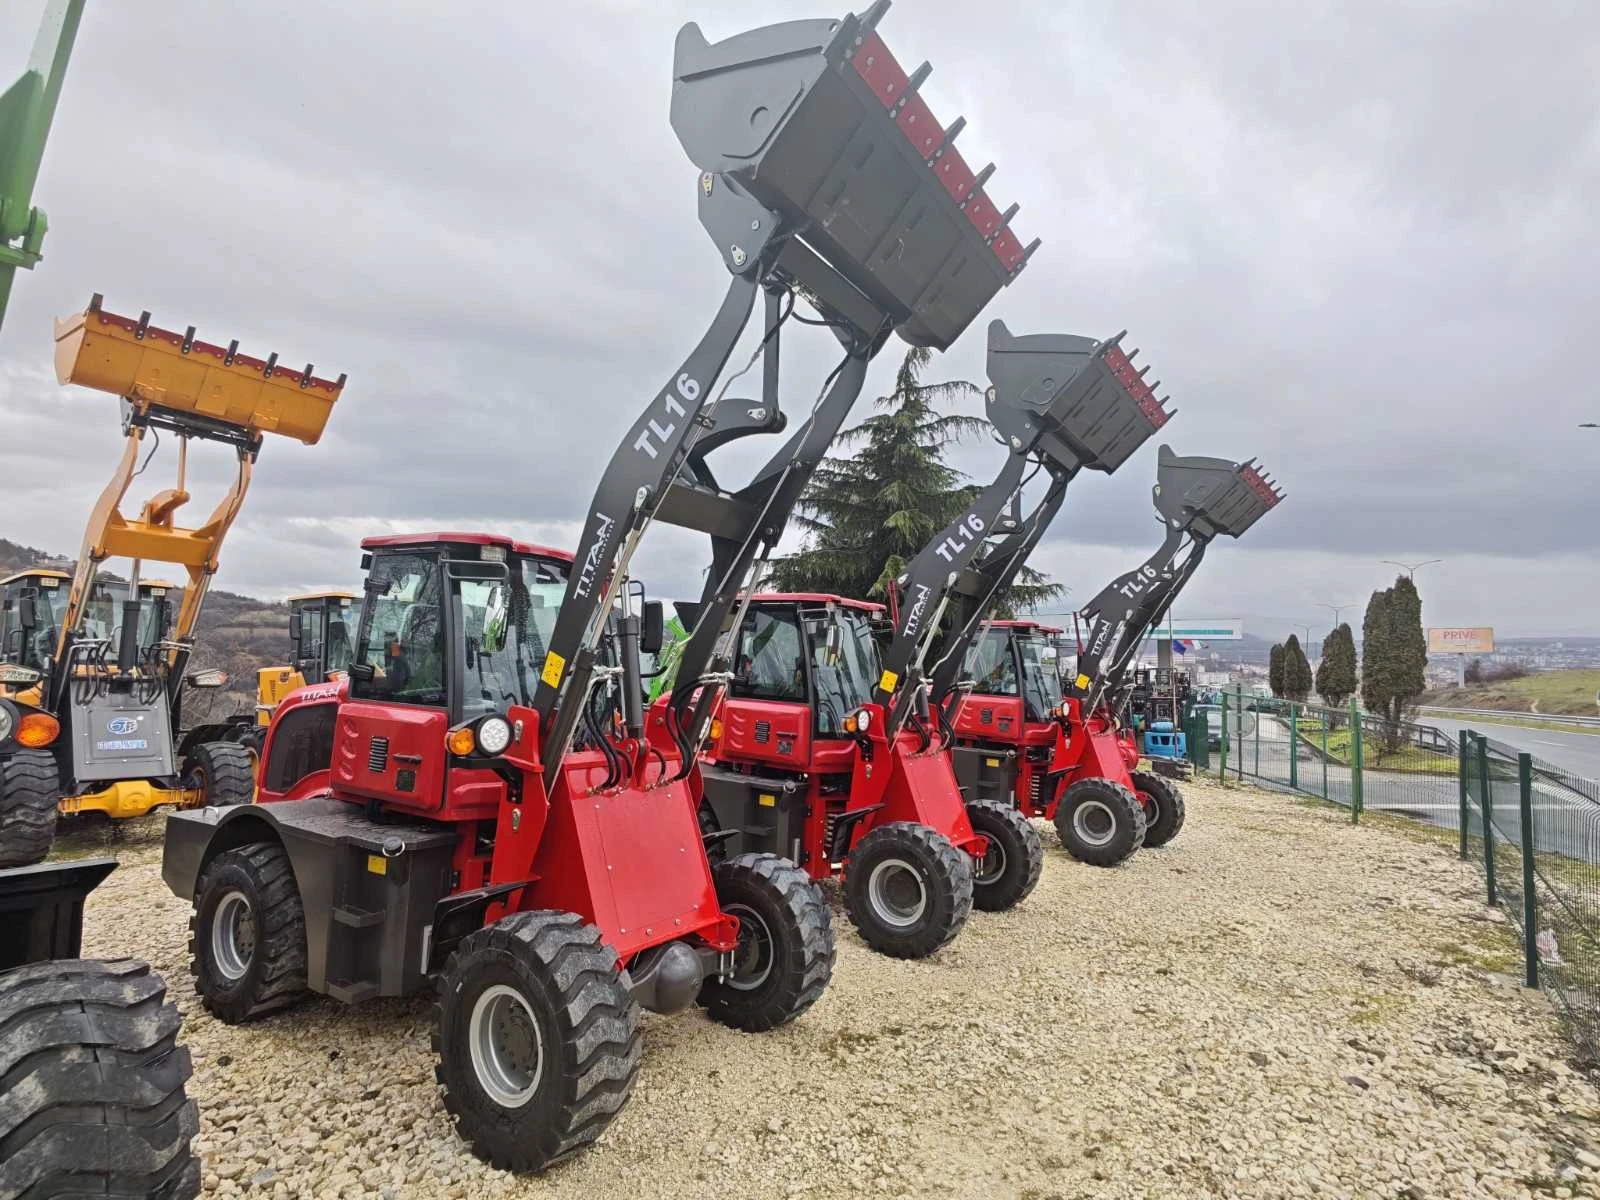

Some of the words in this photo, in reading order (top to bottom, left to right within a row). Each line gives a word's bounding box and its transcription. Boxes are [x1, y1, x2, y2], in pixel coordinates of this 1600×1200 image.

[633, 372, 701, 460] TL16
[573, 512, 612, 600] TITAN
[935, 513, 985, 563] TL16
[1120, 564, 1157, 599] TL16
[903, 583, 929, 637] TITAN
[1090, 620, 1112, 656] TITAN
